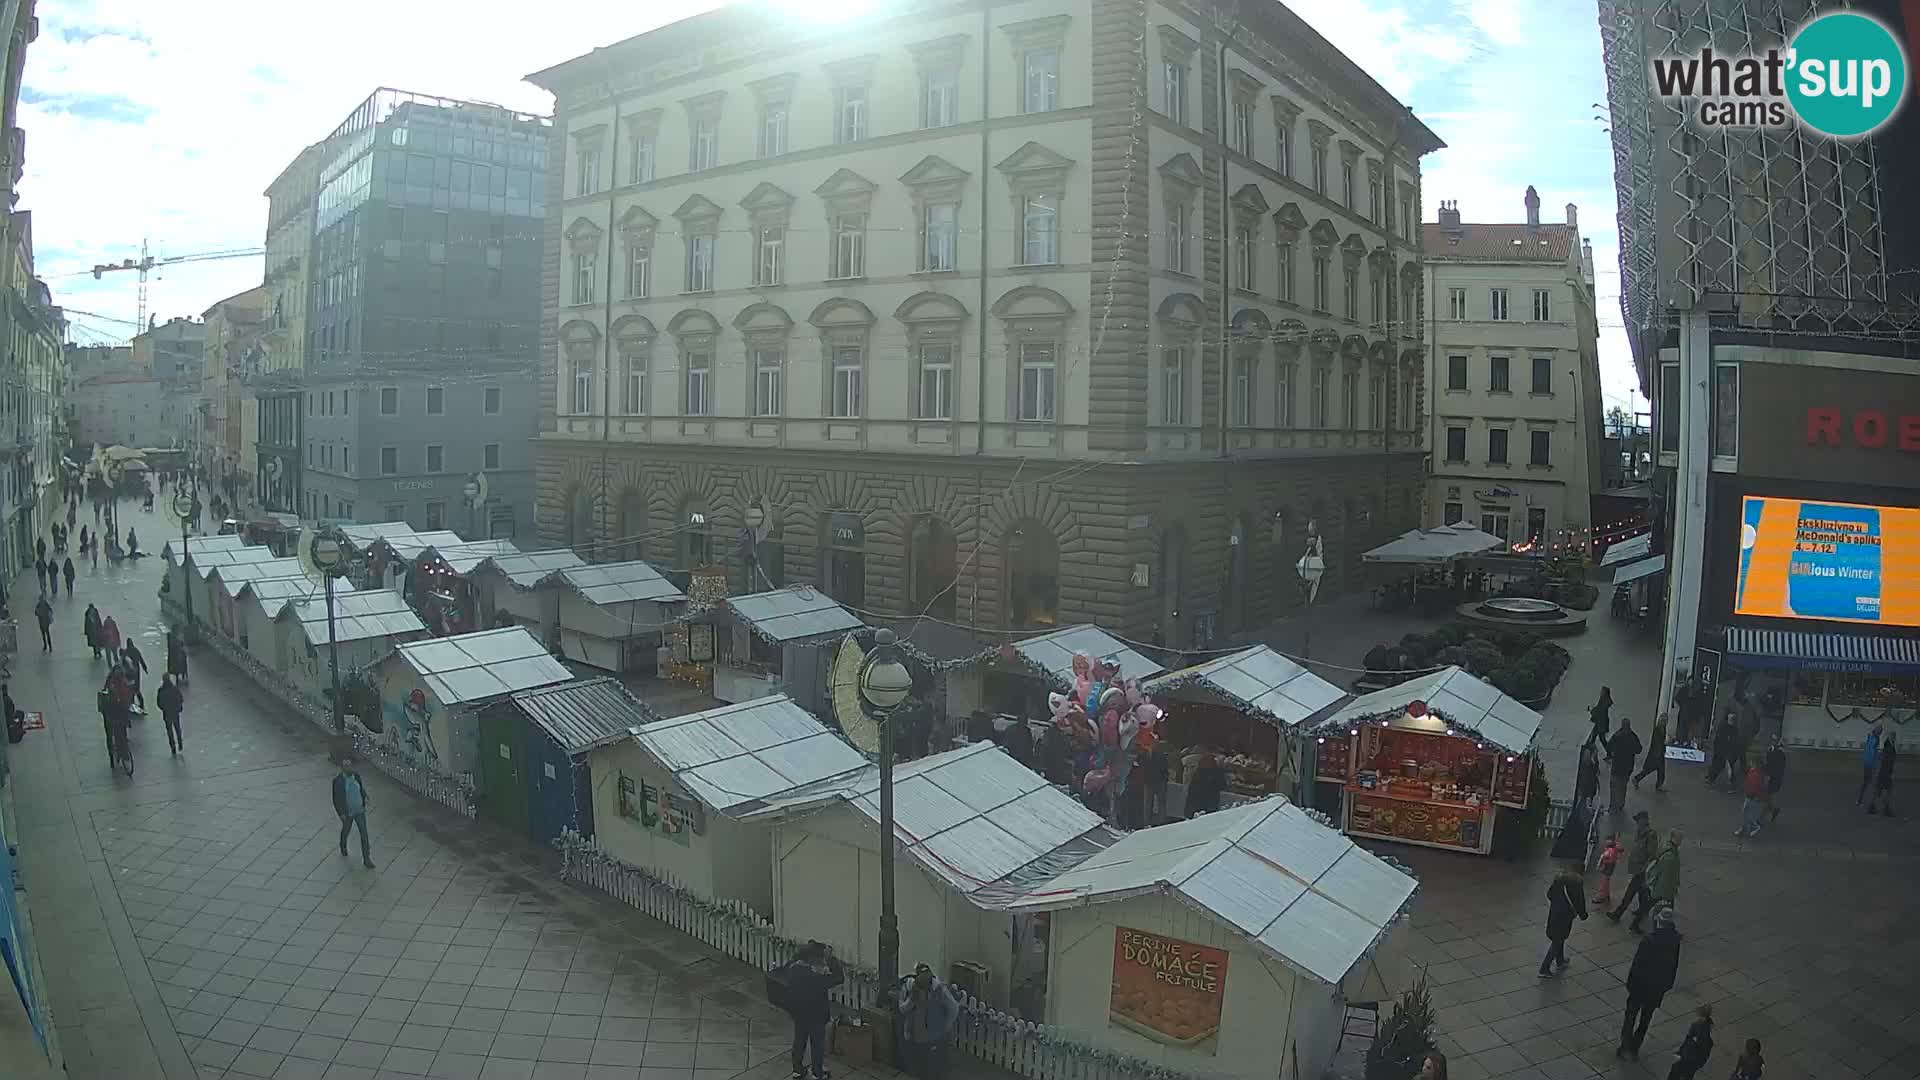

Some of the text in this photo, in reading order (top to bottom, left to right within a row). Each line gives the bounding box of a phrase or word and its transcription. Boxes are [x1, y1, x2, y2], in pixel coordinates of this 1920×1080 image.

[1797, 519, 1855, 532] Ekskluzivno
[1796, 531, 1851, 544] McDonald's
[1838, 565, 1873, 580] Winter
[1123, 931, 1181, 955] PERINE
[1122, 943, 1219, 980] DOMAĆE
[1156, 971, 1217, 993] FRITULE
